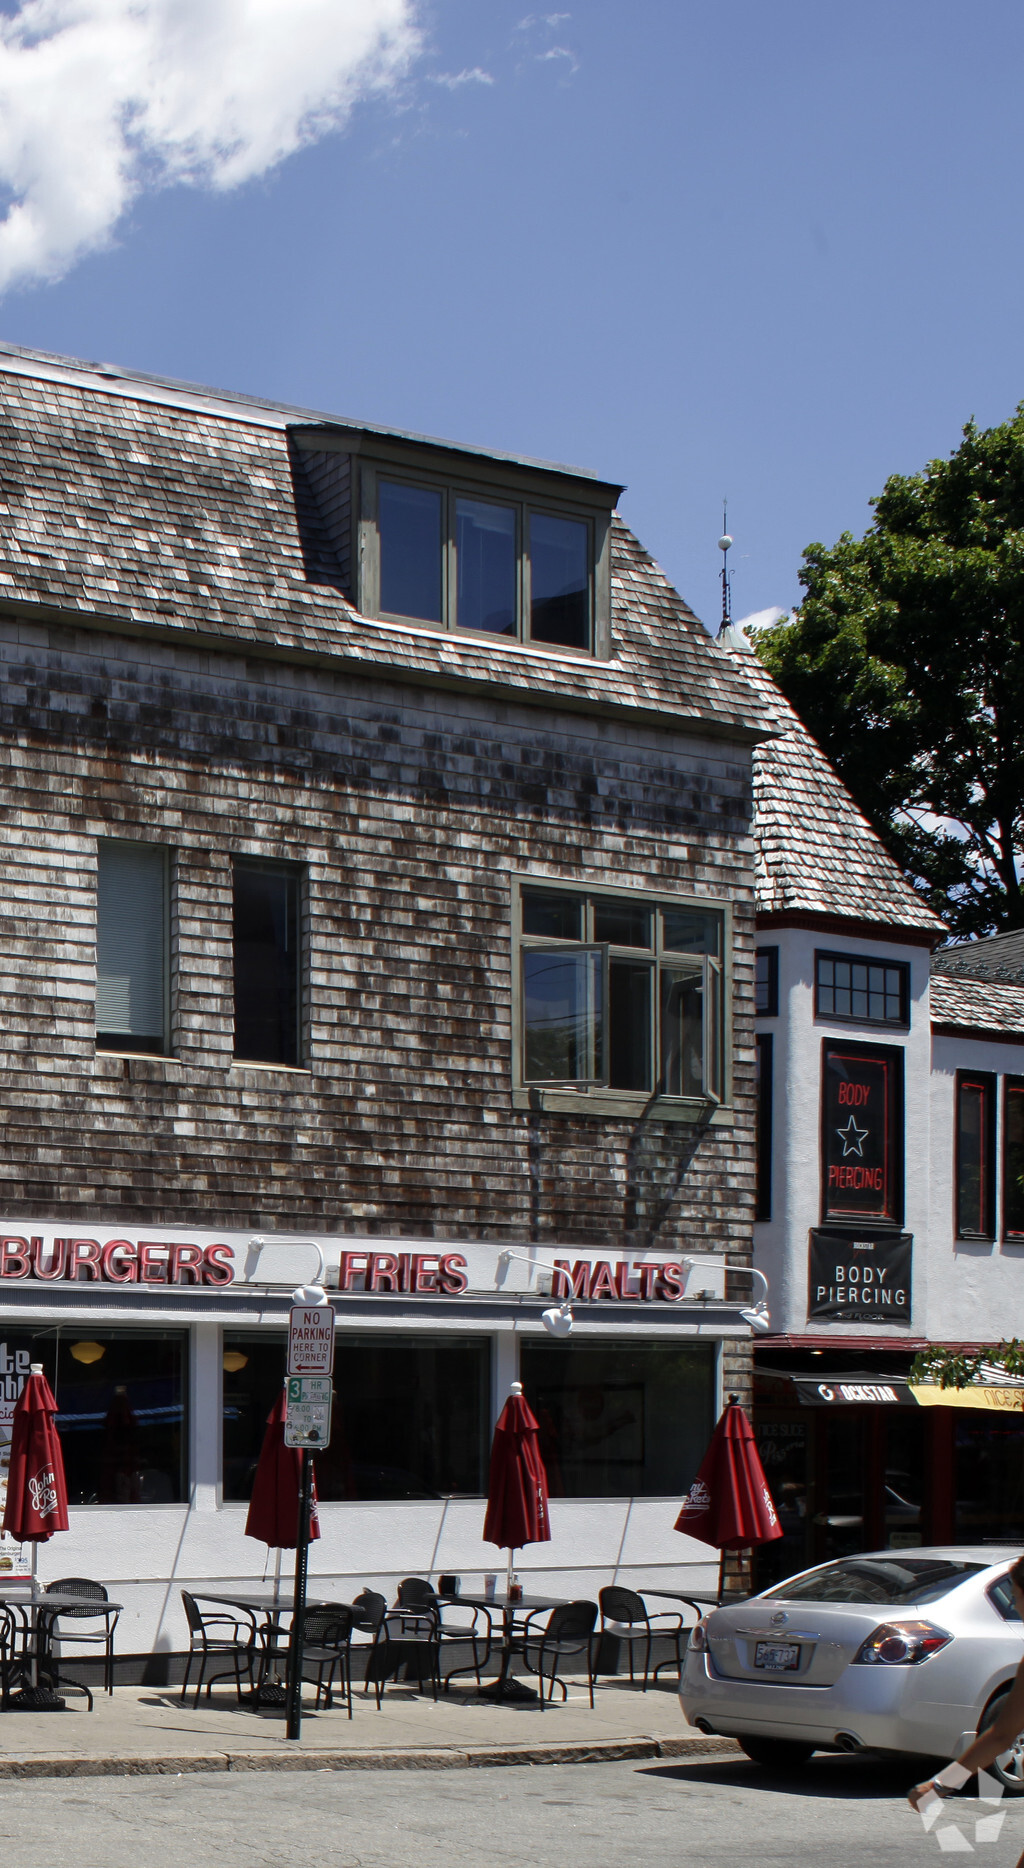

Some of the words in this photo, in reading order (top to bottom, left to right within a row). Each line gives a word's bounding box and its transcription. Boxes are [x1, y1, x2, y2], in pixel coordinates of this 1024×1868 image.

[838, 1082, 871, 1106] BODY
[828, 1165, 883, 1190] PIERCING
[339, 1250, 469, 1294] FRIES
[551, 1259, 685, 1302] MALTS
[835, 1265, 887, 1284] BODY
[816, 1285, 906, 1305] PIERCING
[303, 1311, 321, 1325] NO
[292, 1327, 331, 1340] PARKING
[293, 1342, 315, 1352] HERE
[319, 1342, 329, 1352] TO
[293, 1352, 327, 1362] CORNER
[290, 1380, 301, 1398] 3
[310, 1381, 322, 1390] HR
[983, 1389, 1013, 1407] NICE
